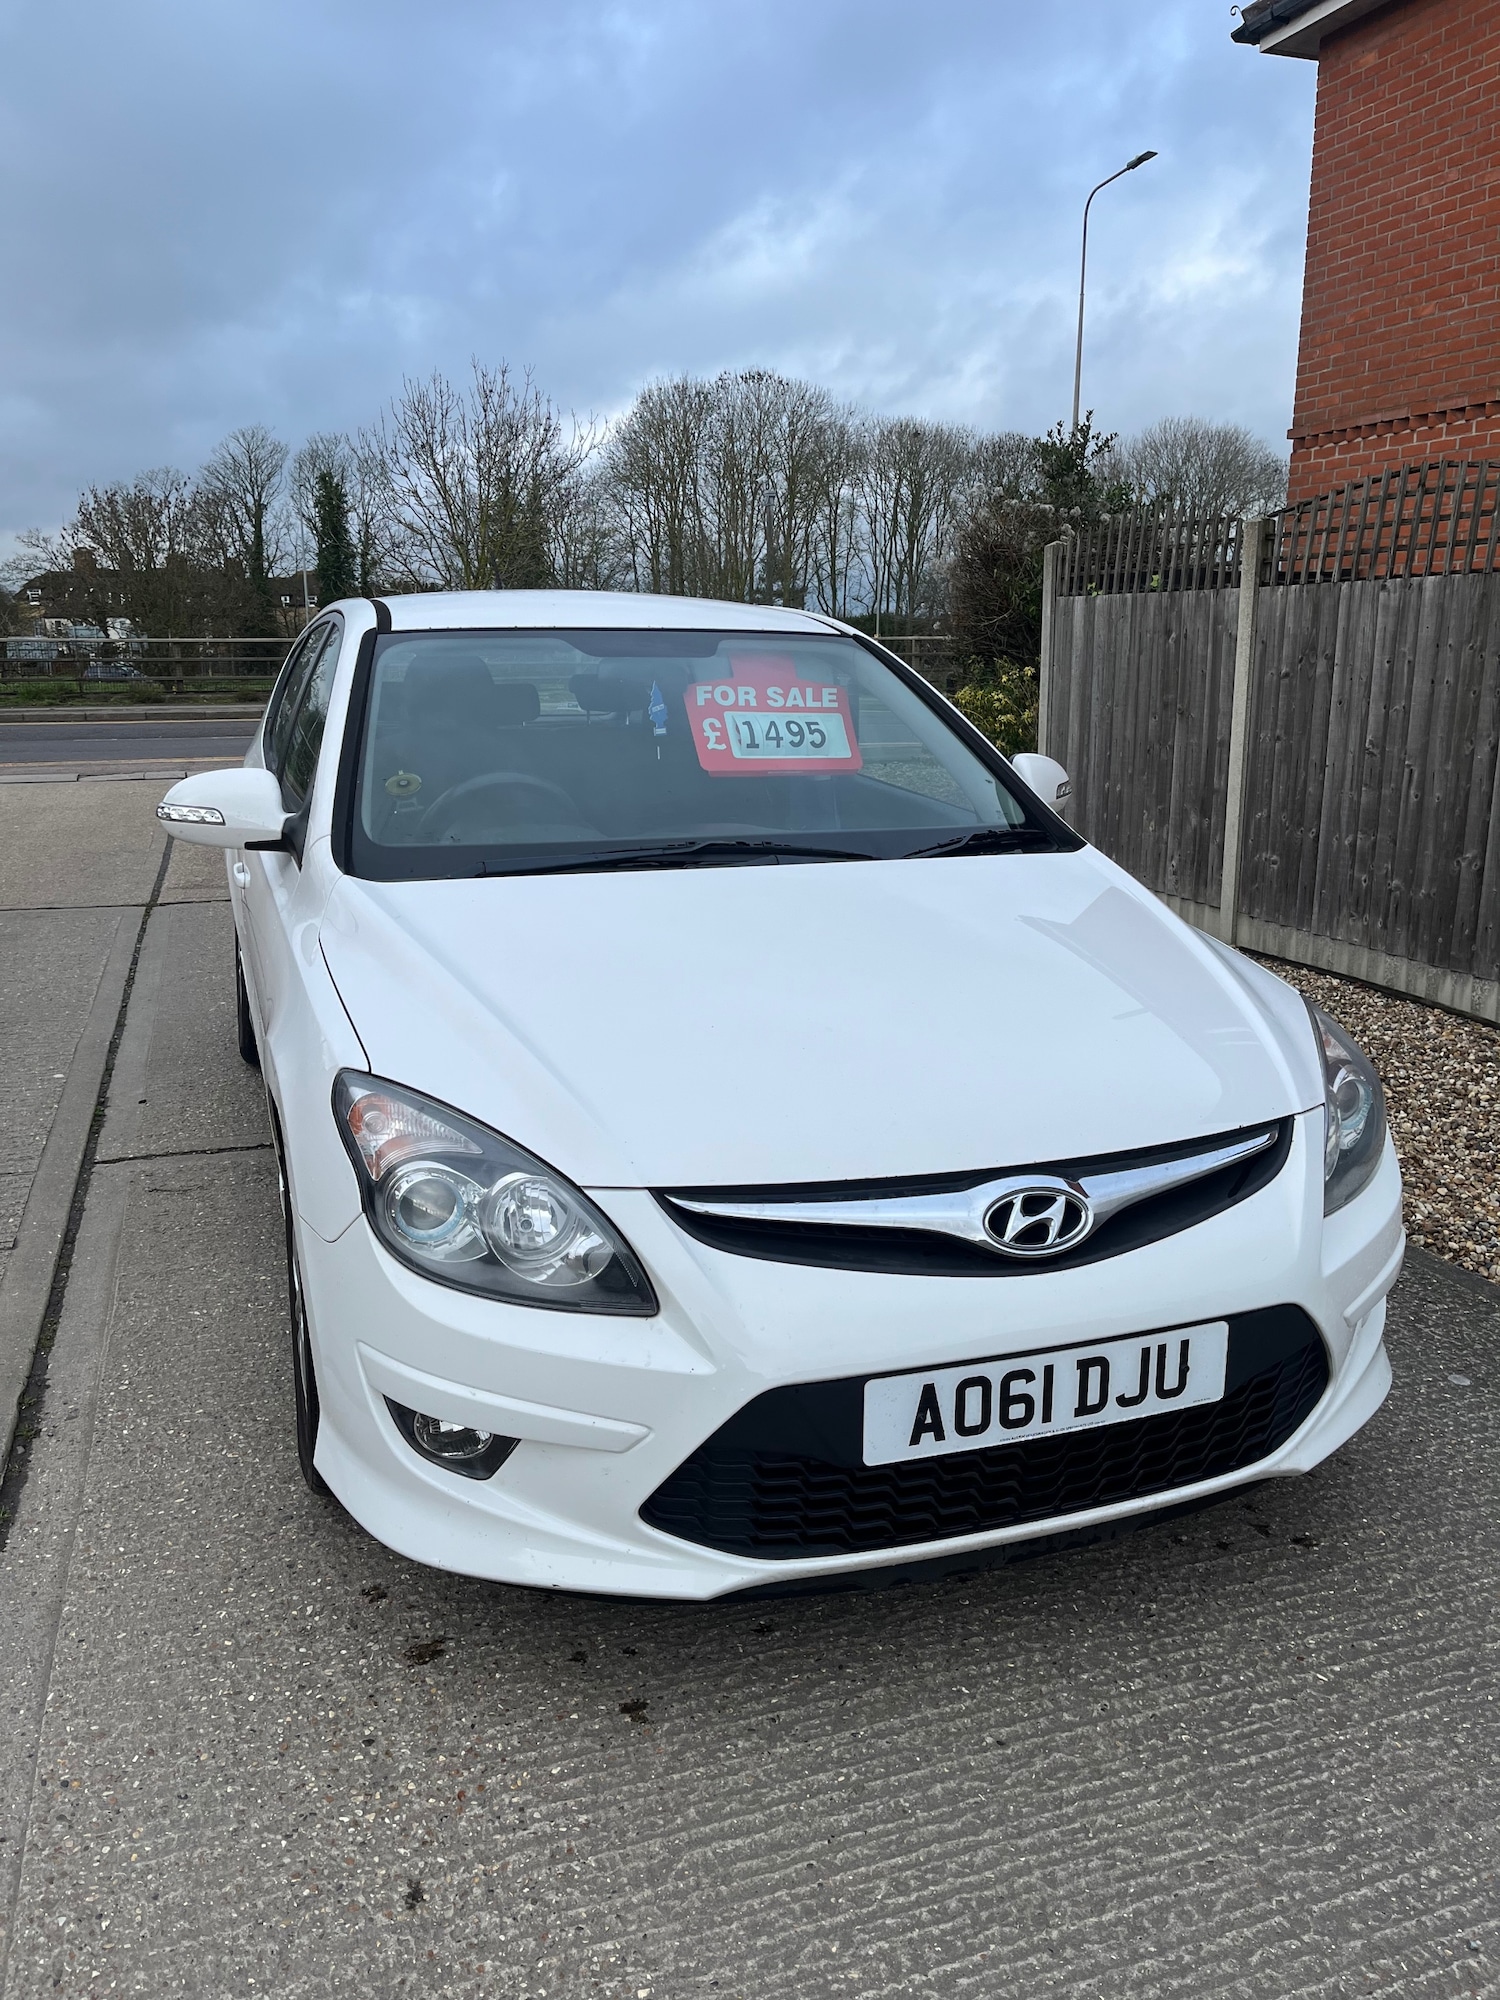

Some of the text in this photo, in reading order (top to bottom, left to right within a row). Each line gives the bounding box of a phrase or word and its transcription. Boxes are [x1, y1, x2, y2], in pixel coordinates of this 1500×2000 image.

[696, 685, 839, 708] FOR SALE
[702, 717, 827, 750] £ 1495
[908, 1338, 1191, 1447] AO61 DJU
